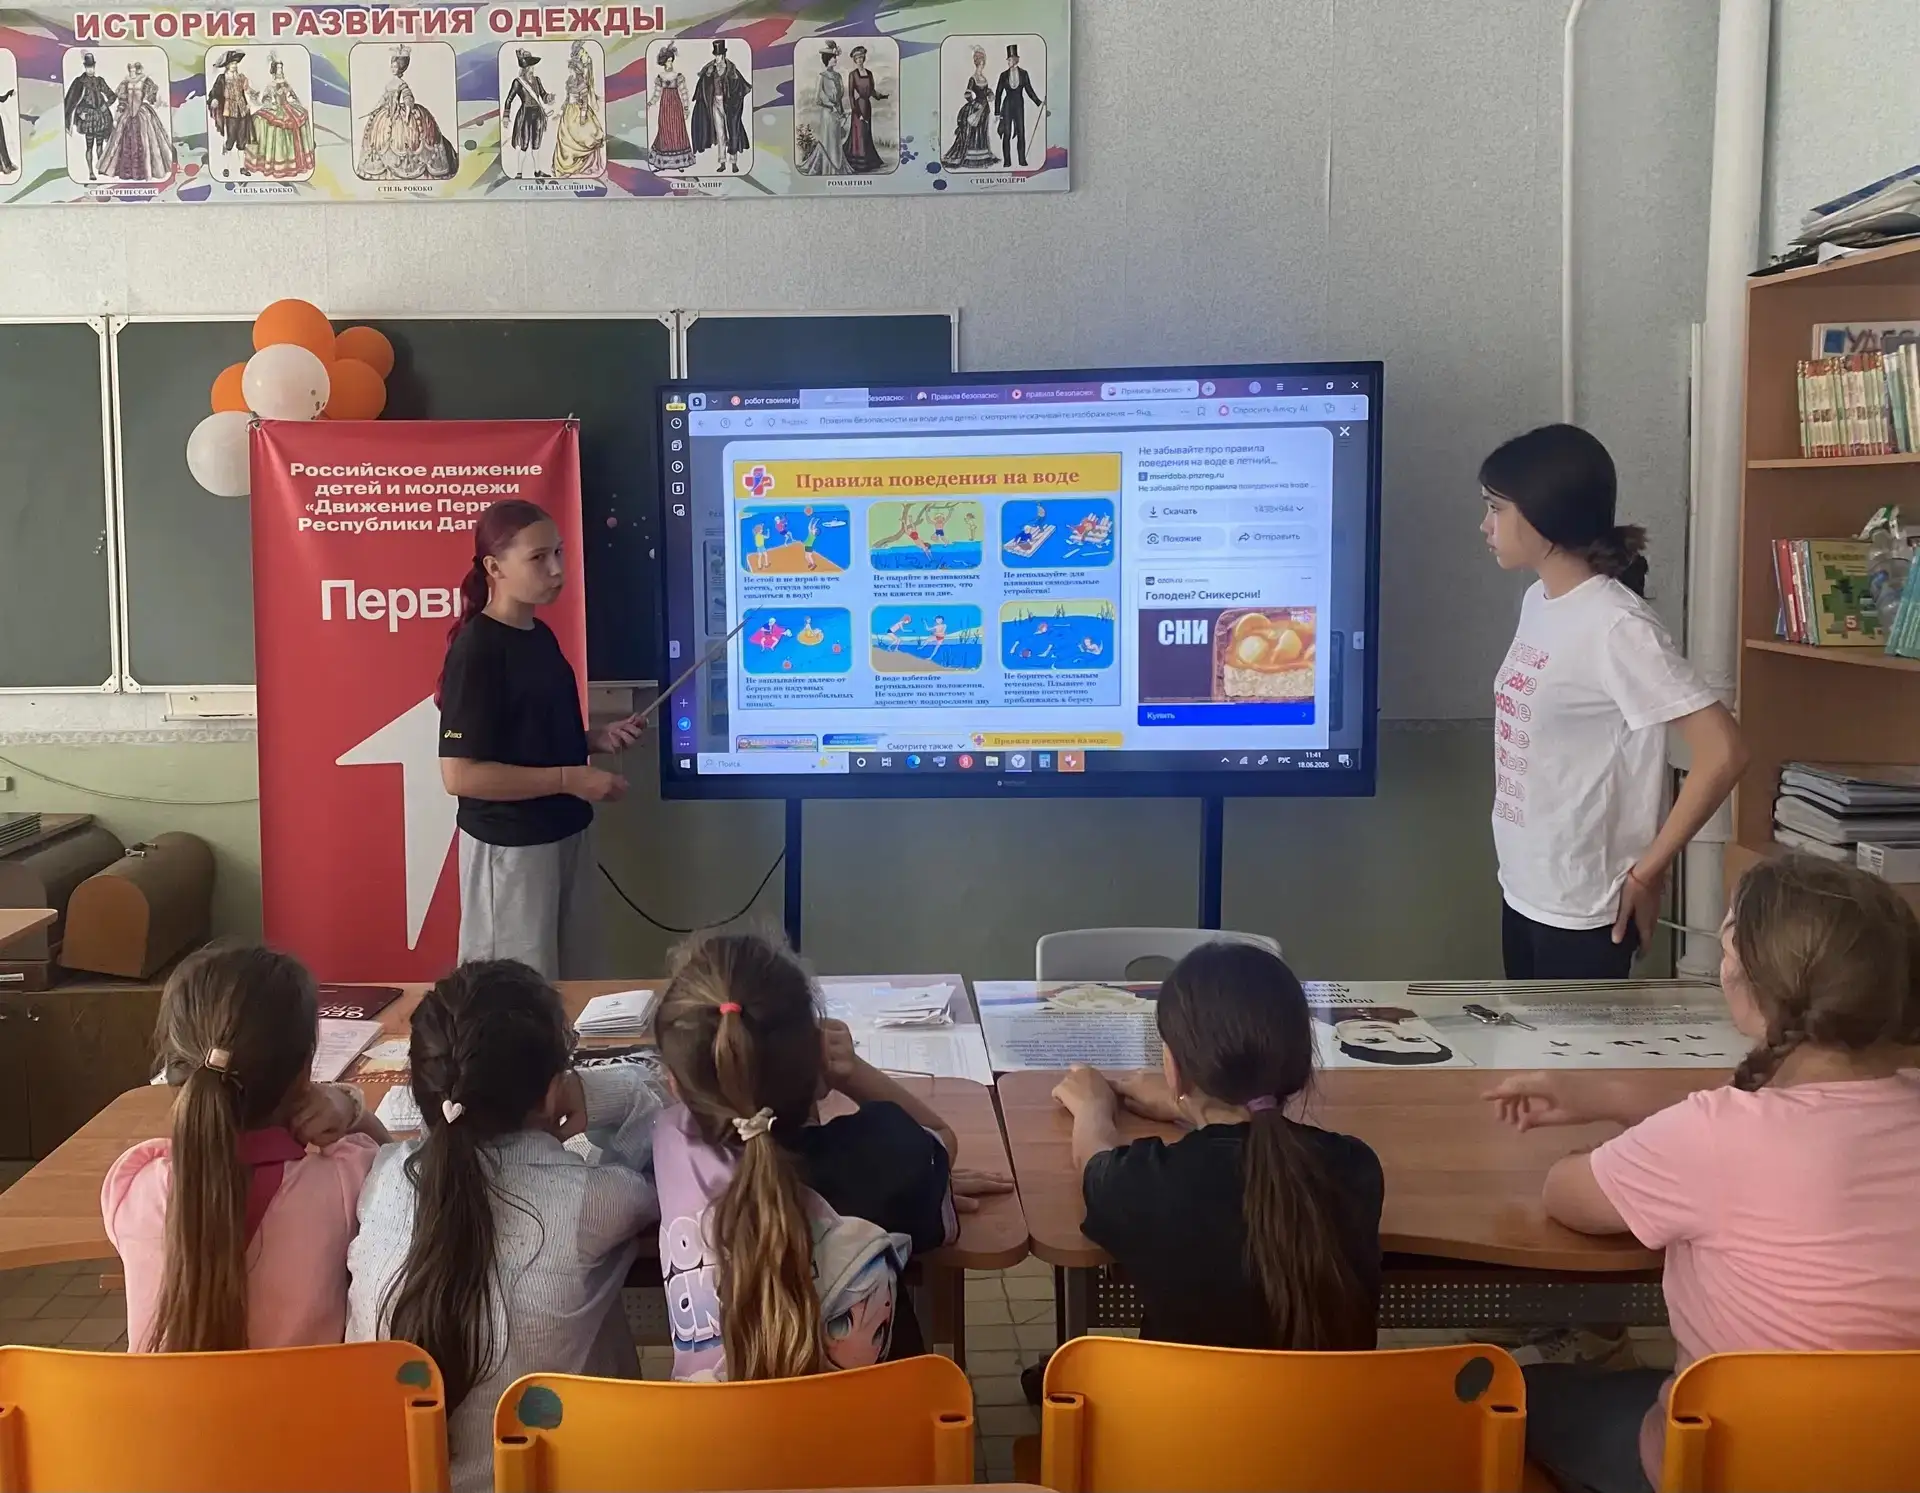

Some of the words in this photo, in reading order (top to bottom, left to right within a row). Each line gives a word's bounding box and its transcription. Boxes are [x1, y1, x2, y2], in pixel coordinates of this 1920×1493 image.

[75, 11, 256, 39] ИСТОРИЯ
[271, 8, 474, 36] РАЗВИТИЯ
[488, 6, 665, 38] ОДЕЖДЫ
[518, 184, 543, 192] СТИЛЬ
[544, 183, 595, 192] КЛАССИЦИЗМ
[671, 181, 695, 189] СТИЛЬ
[697, 181, 723, 189] АМПИР
[827, 179, 873, 187] РОМАНТИЗМ
[115, 188, 158, 196] РЕНЕССАНС
[259, 186, 293, 194] БАРОККО
[377, 185, 402, 193] СТИЛЬ
[403, 185, 433, 193] РОКОКО
[931, 393, 960, 401] Правила
[1026, 391, 1054, 399] правила
[744, 396, 764, 406] робот
[765, 397, 791, 405] своими
[1232, 405, 1270, 415] Спросить
[854, 415, 908, 425] безопасности
[919, 415, 938, 424] воде
[939, 415, 954, 424] для
[980, 413, 1018, 422] смотрите
[1071, 410, 1126, 420] изображения
[1138, 447, 1151, 455] Не
[1152, 445, 1203, 455] забывайте
[1204, 446, 1224, 455] про
[1225, 445, 1265, 454] правила
[1138, 459, 1190, 468] поведения
[1190, 459, 1202, 467] на
[1203, 458, 1228, 467] воде
[290, 461, 427, 477] Российское
[431, 463, 543, 479] движение
[795, 473, 885, 492] Правила
[888, 472, 998, 489] поведения
[1003, 472, 1027, 485] на
[1032, 470, 1081, 486] воде
[314, 480, 382, 496] детей
[386, 484, 400, 494] и
[404, 482, 520, 496] молодежи
[1150, 484, 1189, 492] забывайте
[1190, 484, 1204, 493] про
[1205, 483, 1237, 492] правила
[304, 500, 432, 515] «Движение
[437, 498, 492, 514] Перв
[1162, 506, 1199, 516] Скачать
[297, 517, 433, 535] Республики
[436, 517, 477, 533] Даг
[1162, 534, 1202, 544] Похожие
[1253, 532, 1301, 542] Отправить
[1003, 571, 1015, 579] Не
[802, 583, 831, 591] можно
[792, 591, 814, 600] воду!
[1145, 590, 1196, 601] Голоден?
[1198, 589, 1261, 601] Сникерсни!
[1846, 615, 1857, 628] 5
[1157, 619, 1209, 646] СНИ
[1146, 711, 1176, 721] Купить
[886, 741, 926, 751] Смотрите
[926, 741, 954, 750] также
[1277, 756, 1291, 764] РУС
